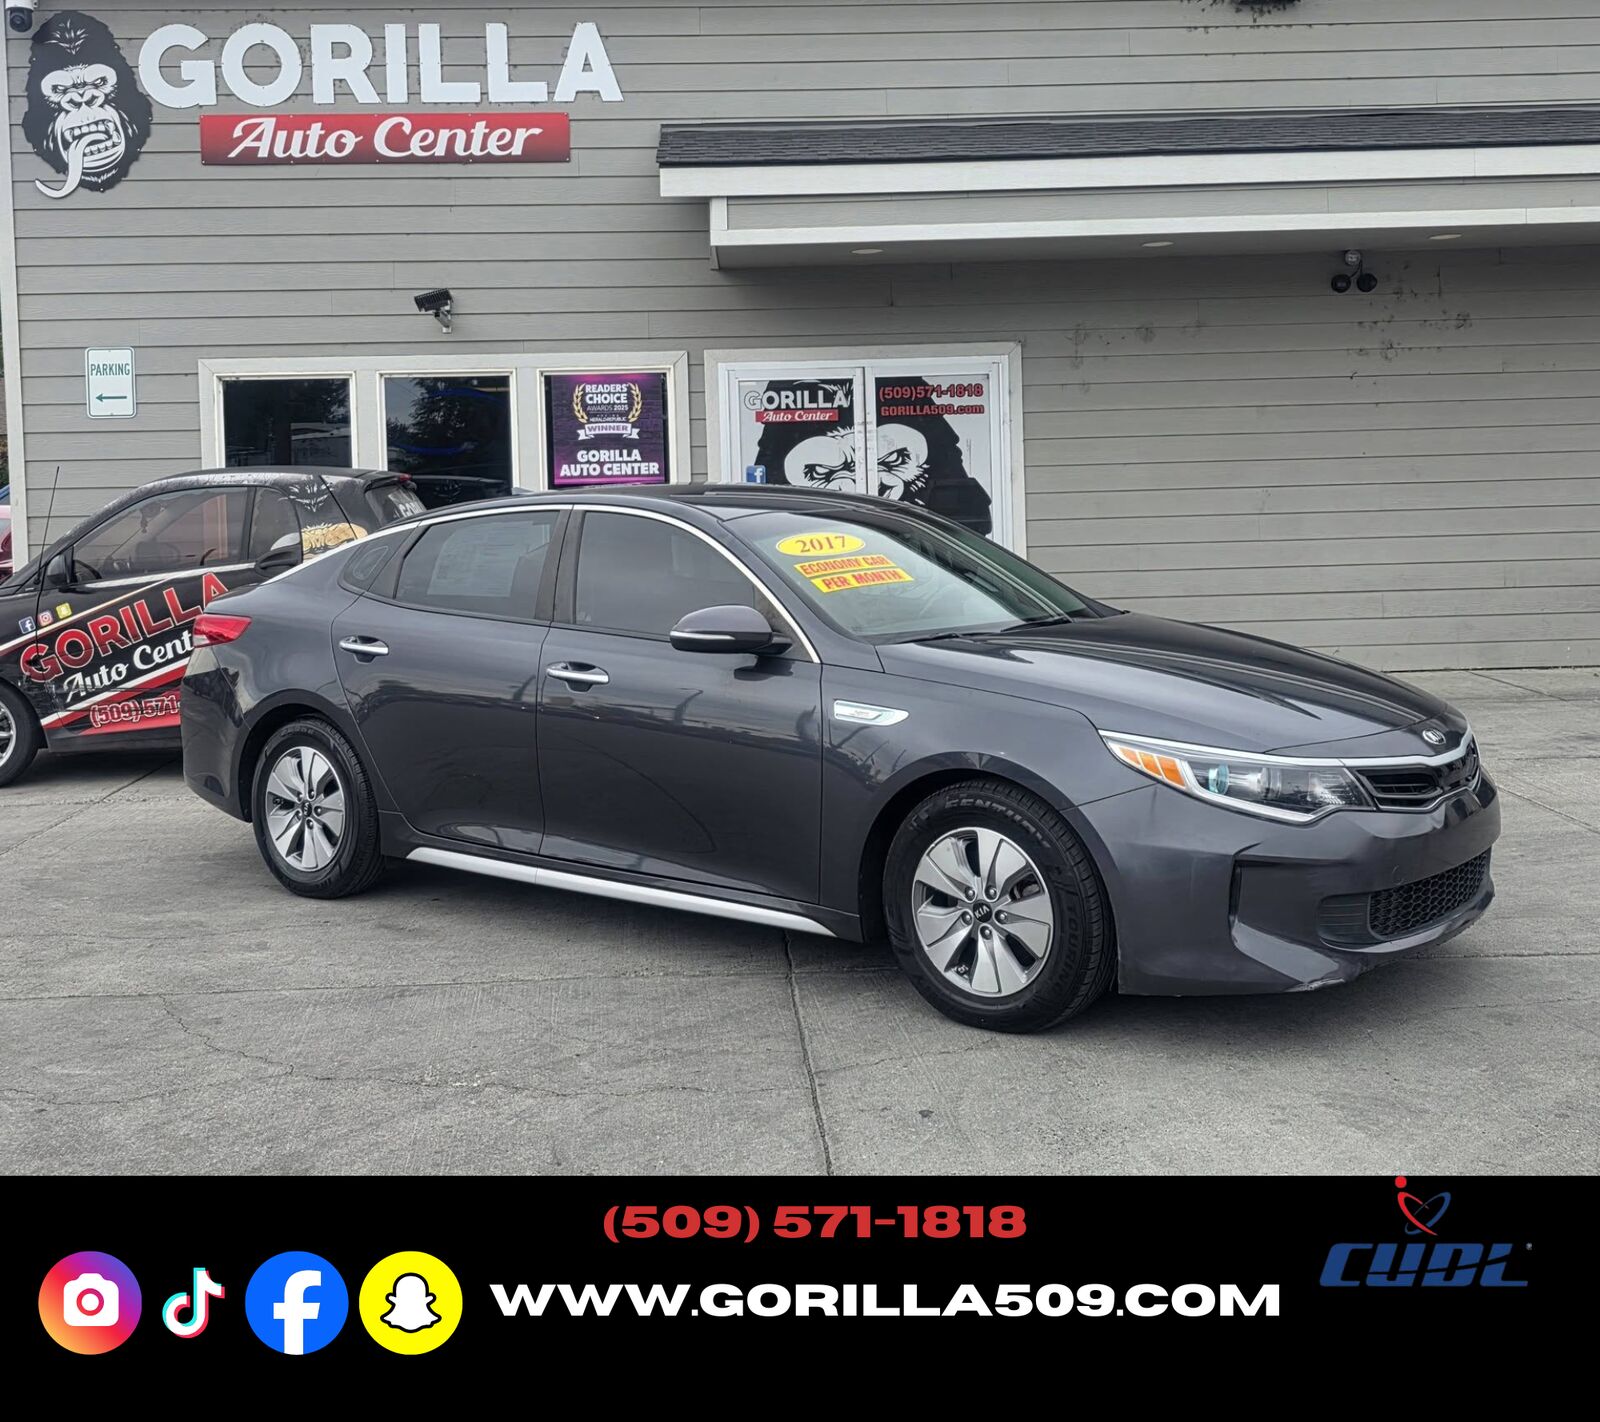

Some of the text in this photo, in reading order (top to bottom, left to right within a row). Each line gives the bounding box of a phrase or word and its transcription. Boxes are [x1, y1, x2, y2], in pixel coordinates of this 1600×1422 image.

[138, 22, 624, 108] GORILLA
[227, 115, 543, 160] Auto Center
[90, 363, 131, 376] PARKING
[585, 393, 628, 404] CHOICE
[744, 390, 850, 411] GORILLA
[880, 383, 984, 401] (509)571-1818
[762, 410, 833, 422] Auto Center
[881, 404, 985, 416] GORILLA509.com
[587, 424, 628, 432] WINNER
[577, 449, 641, 462] GORILLA
[560, 462, 659, 476] AUTO CENTER
[795, 535, 846, 553] 2017
[800, 555, 892, 575] ECONOMY CAR
[822, 569, 904, 590] PER MONTH
[20, 572, 229, 682] GORILLA
[63, 629, 194, 703] Auto Cent
[90, 695, 181, 728] (509) 571-
